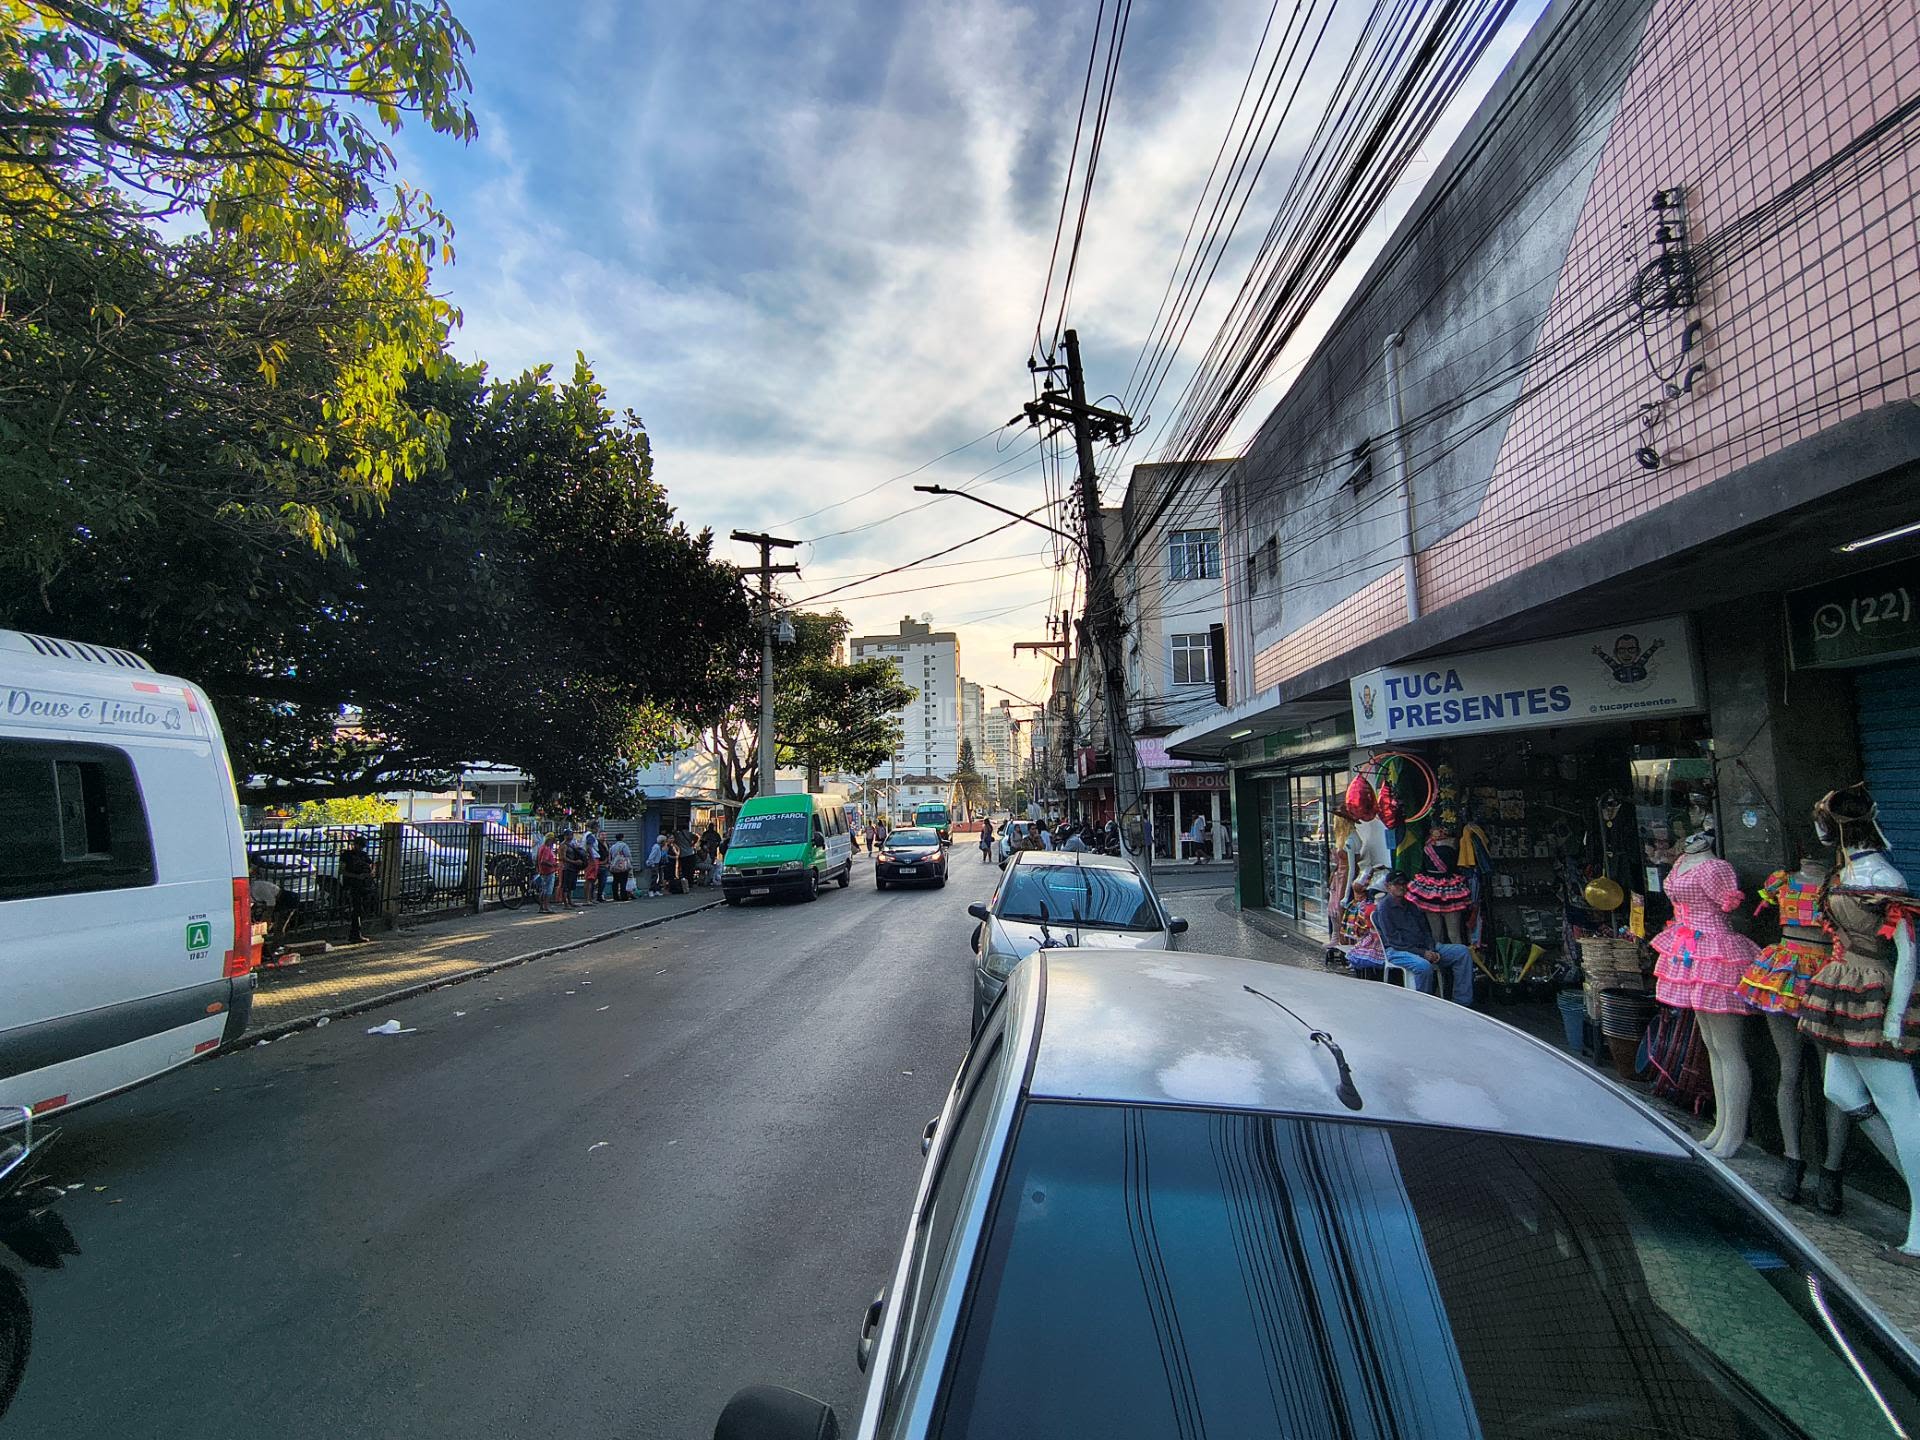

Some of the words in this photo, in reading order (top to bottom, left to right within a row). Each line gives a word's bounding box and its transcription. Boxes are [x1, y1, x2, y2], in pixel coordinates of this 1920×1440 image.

[1850, 587, 1911, 632] (22)
[1385, 669, 1464, 701] TUCA
[6, 689, 74, 718] Deus
[77, 702, 94, 719] é
[98, 700, 160, 725] Lindo
[1388, 685, 1572, 730] PRESENTES
[735, 822, 762, 830] CENTRO
[744, 815, 777, 823] CAMPOS
[780, 812, 806, 820] FAROL
[193, 928, 205, 945] A
